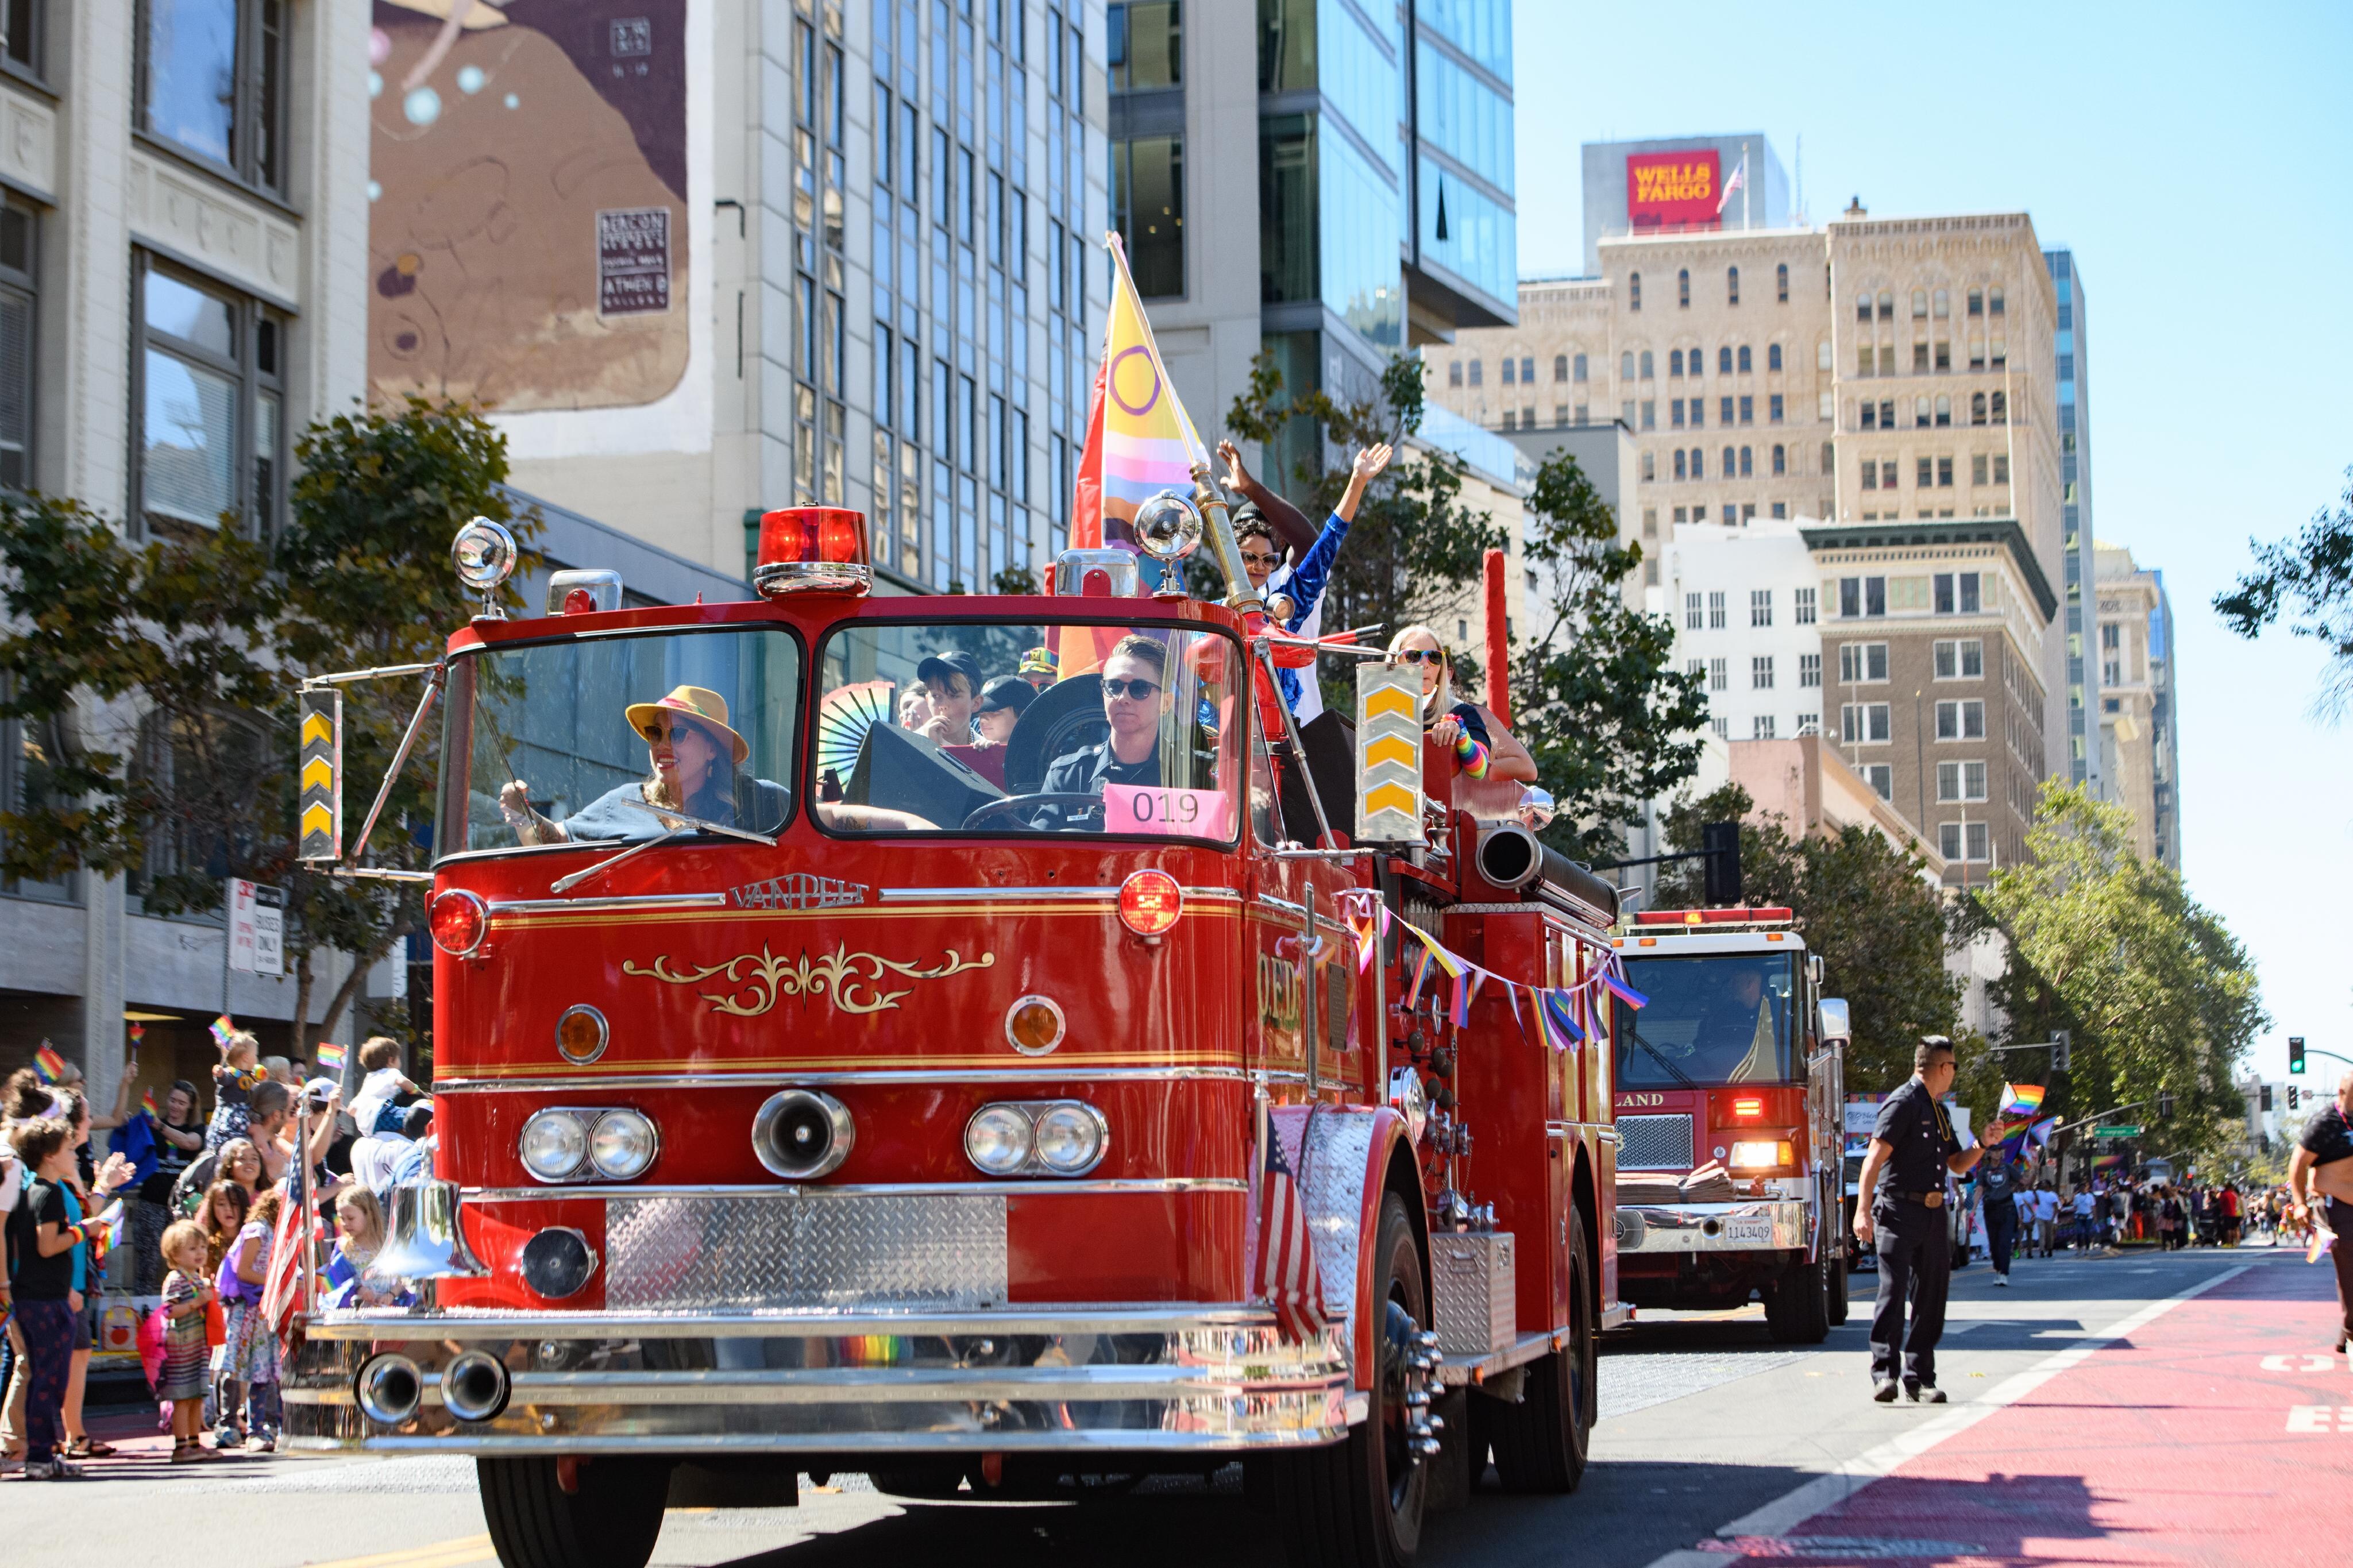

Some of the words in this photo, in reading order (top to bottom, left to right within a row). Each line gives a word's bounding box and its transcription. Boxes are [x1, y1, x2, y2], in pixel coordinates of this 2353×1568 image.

[1634, 163, 1711, 184] WELLS
[1637, 183, 1711, 203] FARGO
[1133, 793, 1198, 823] 019
[1728, 1226, 1770, 1238] 1143409
